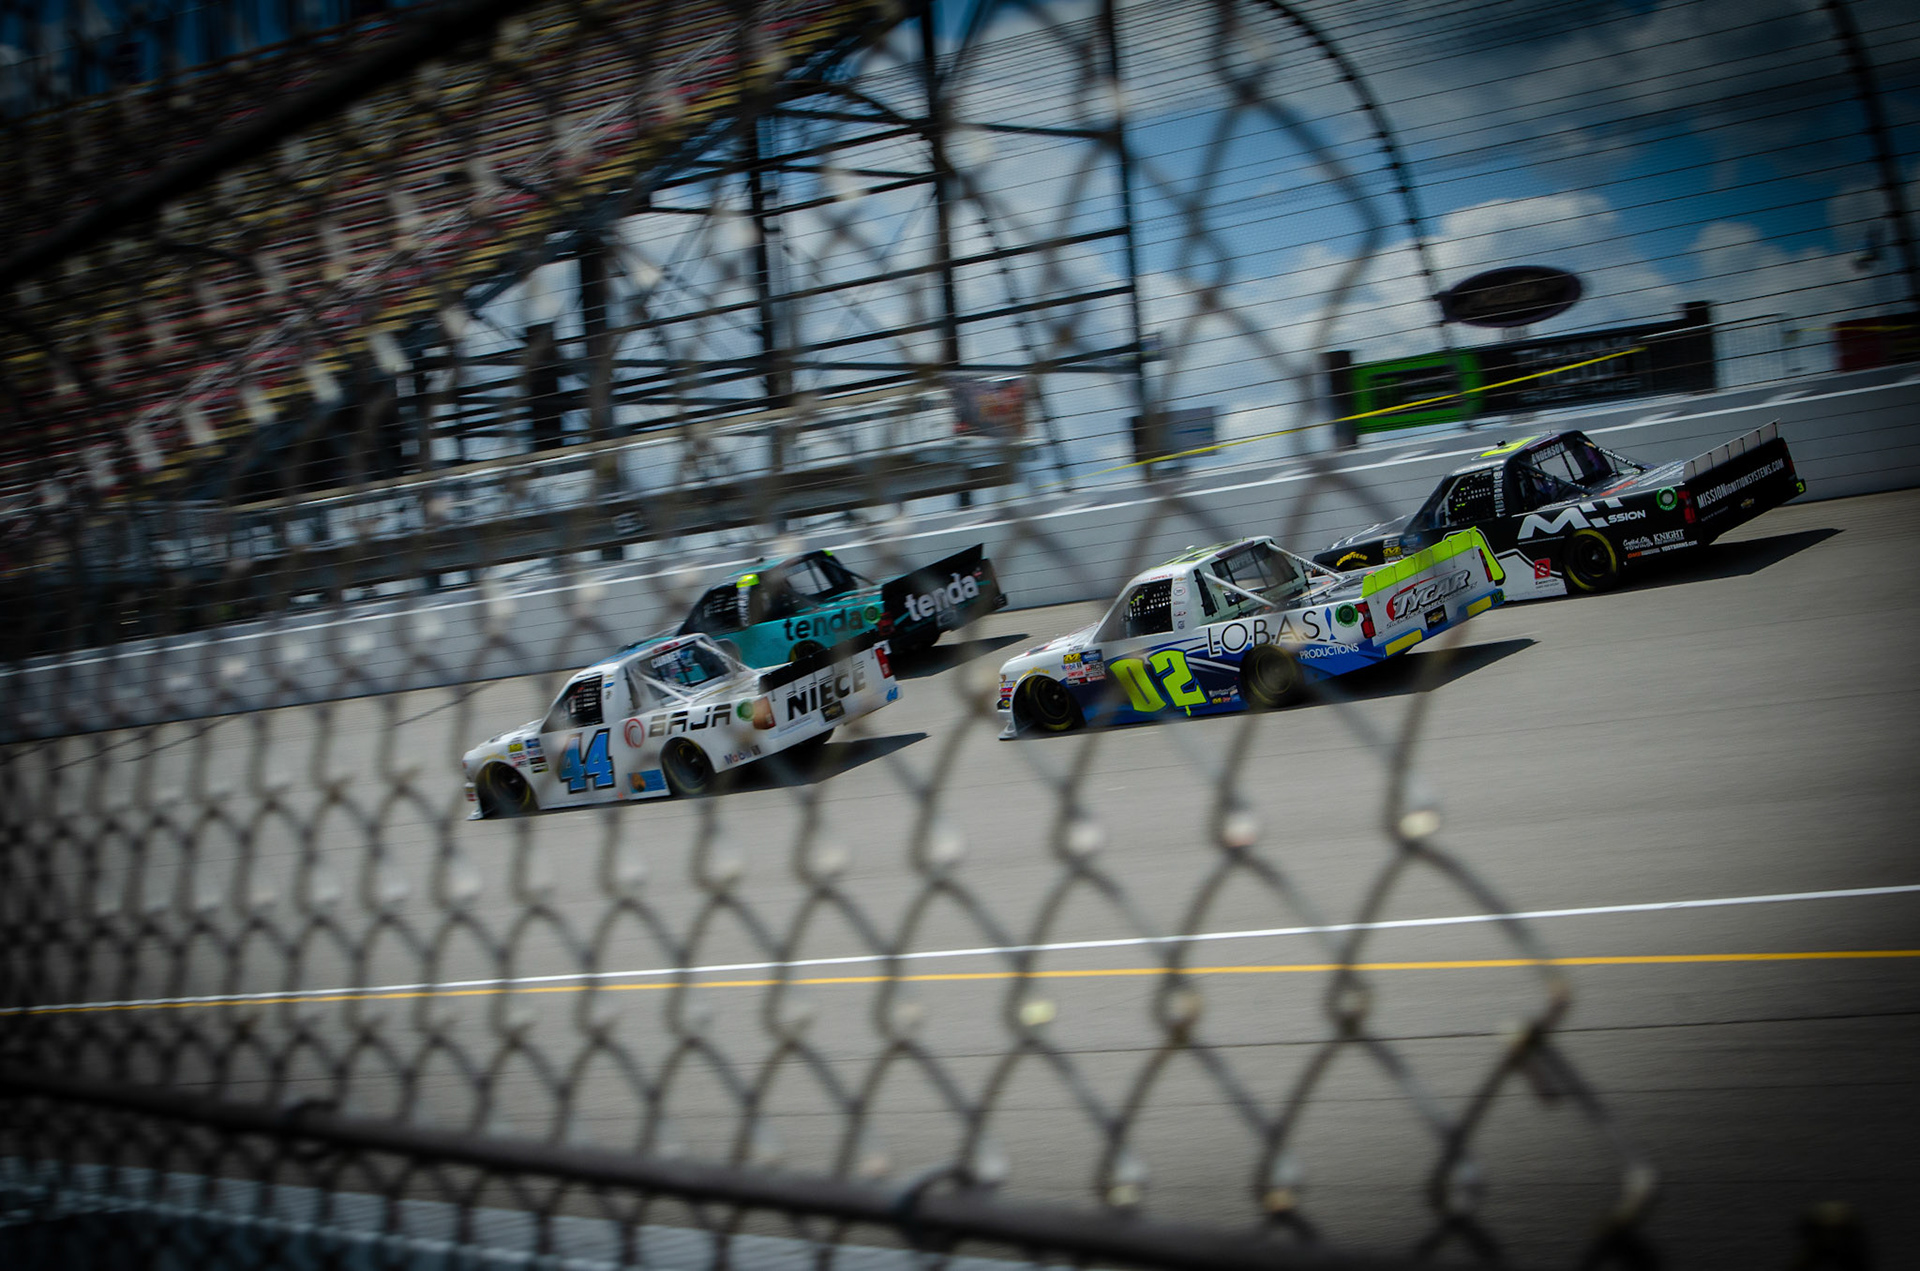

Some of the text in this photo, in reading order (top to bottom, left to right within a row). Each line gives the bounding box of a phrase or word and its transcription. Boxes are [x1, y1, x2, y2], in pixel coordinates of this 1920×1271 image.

[1796, 482, 1805, 493] 3
[1653, 529, 1684, 542] KNIGHT
[1336, 551, 1368, 567] GOODYEAR
[904, 572, 980, 621] tenda
[1393, 570, 1470, 620] TYCAR
[784, 608, 864, 641] tenda
[1299, 643, 1361, 660] PRODUCTIONS
[787, 668, 867, 722] NIECE
[885, 687, 899, 703] 44
[1110, 649, 1208, 713] 02
[648, 702, 732, 738] BAJA
[559, 728, 617, 796] 44
